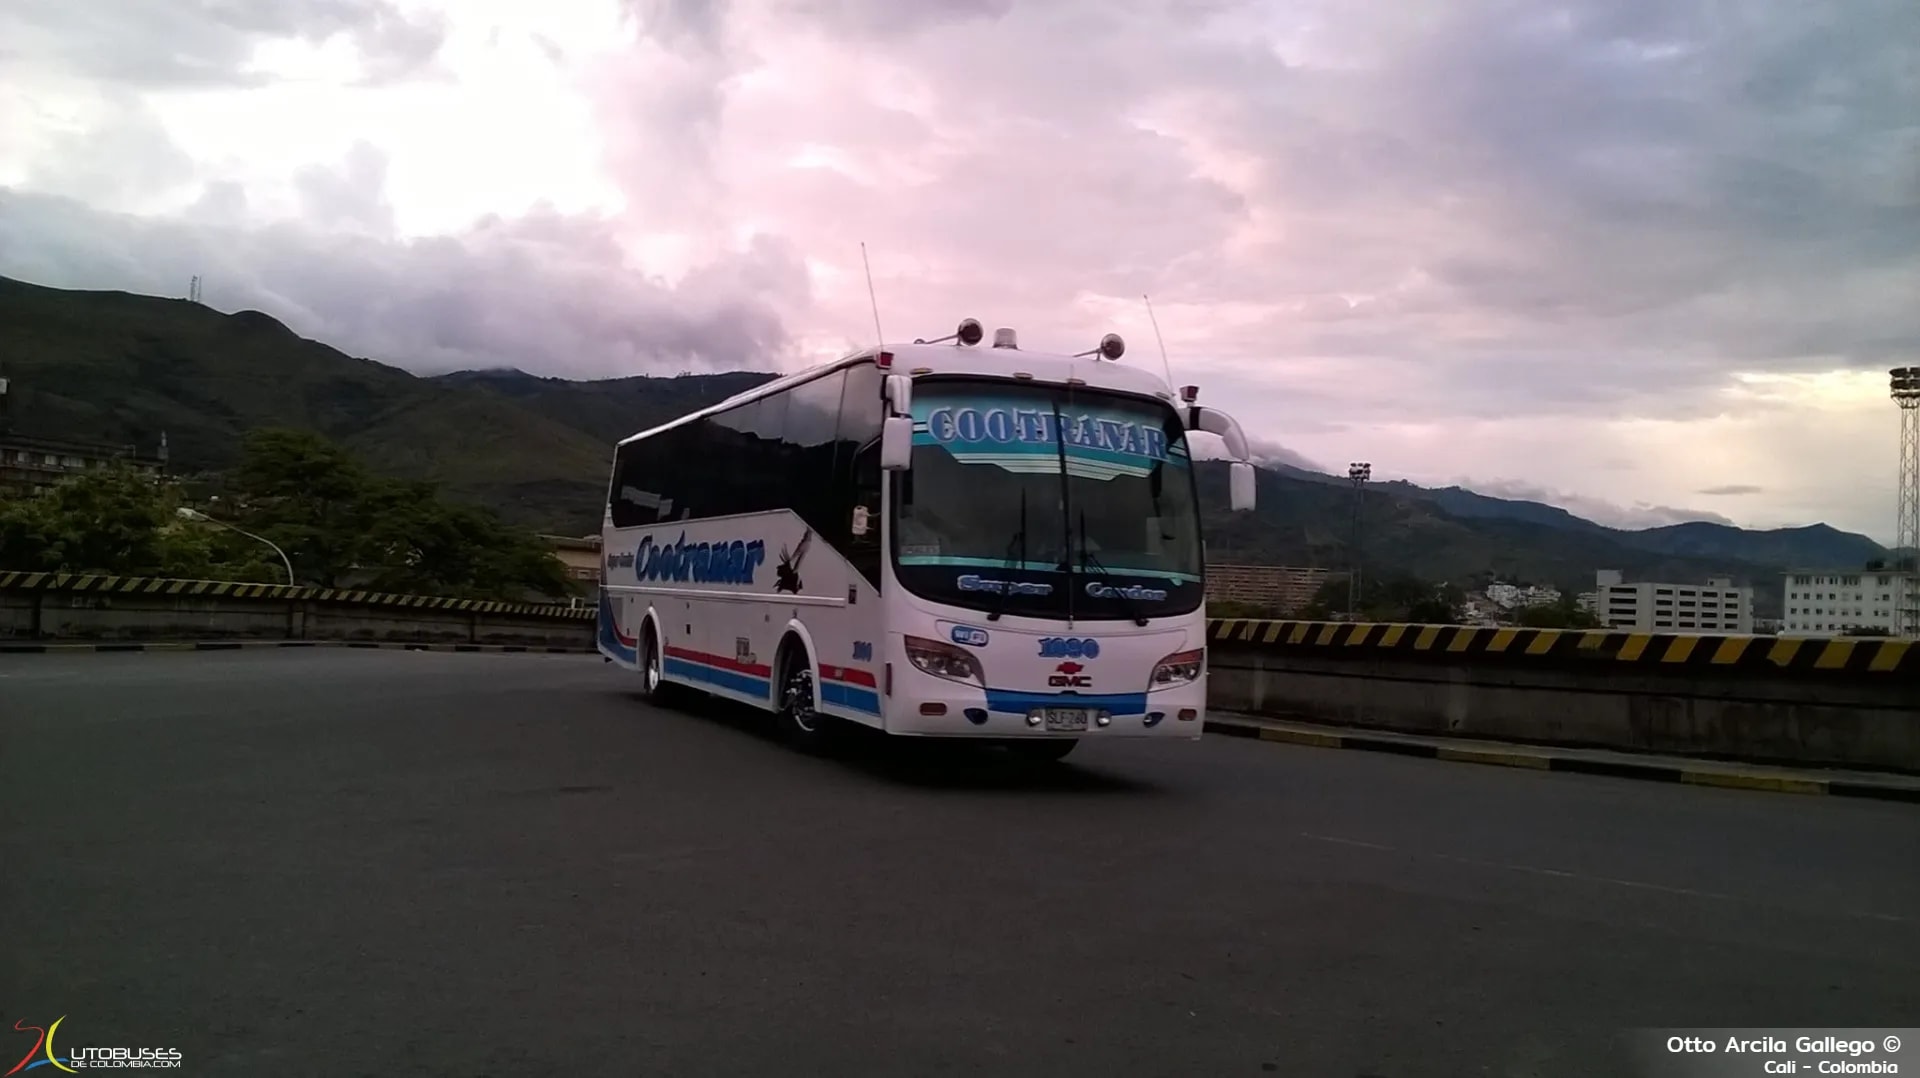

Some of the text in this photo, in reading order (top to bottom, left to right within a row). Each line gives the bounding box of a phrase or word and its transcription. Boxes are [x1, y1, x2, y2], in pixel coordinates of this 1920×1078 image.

[927, 406, 1169, 462] COOTRANAR
[635, 530, 765, 585] Cootranar
[1048, 676, 1092, 687] GMC
